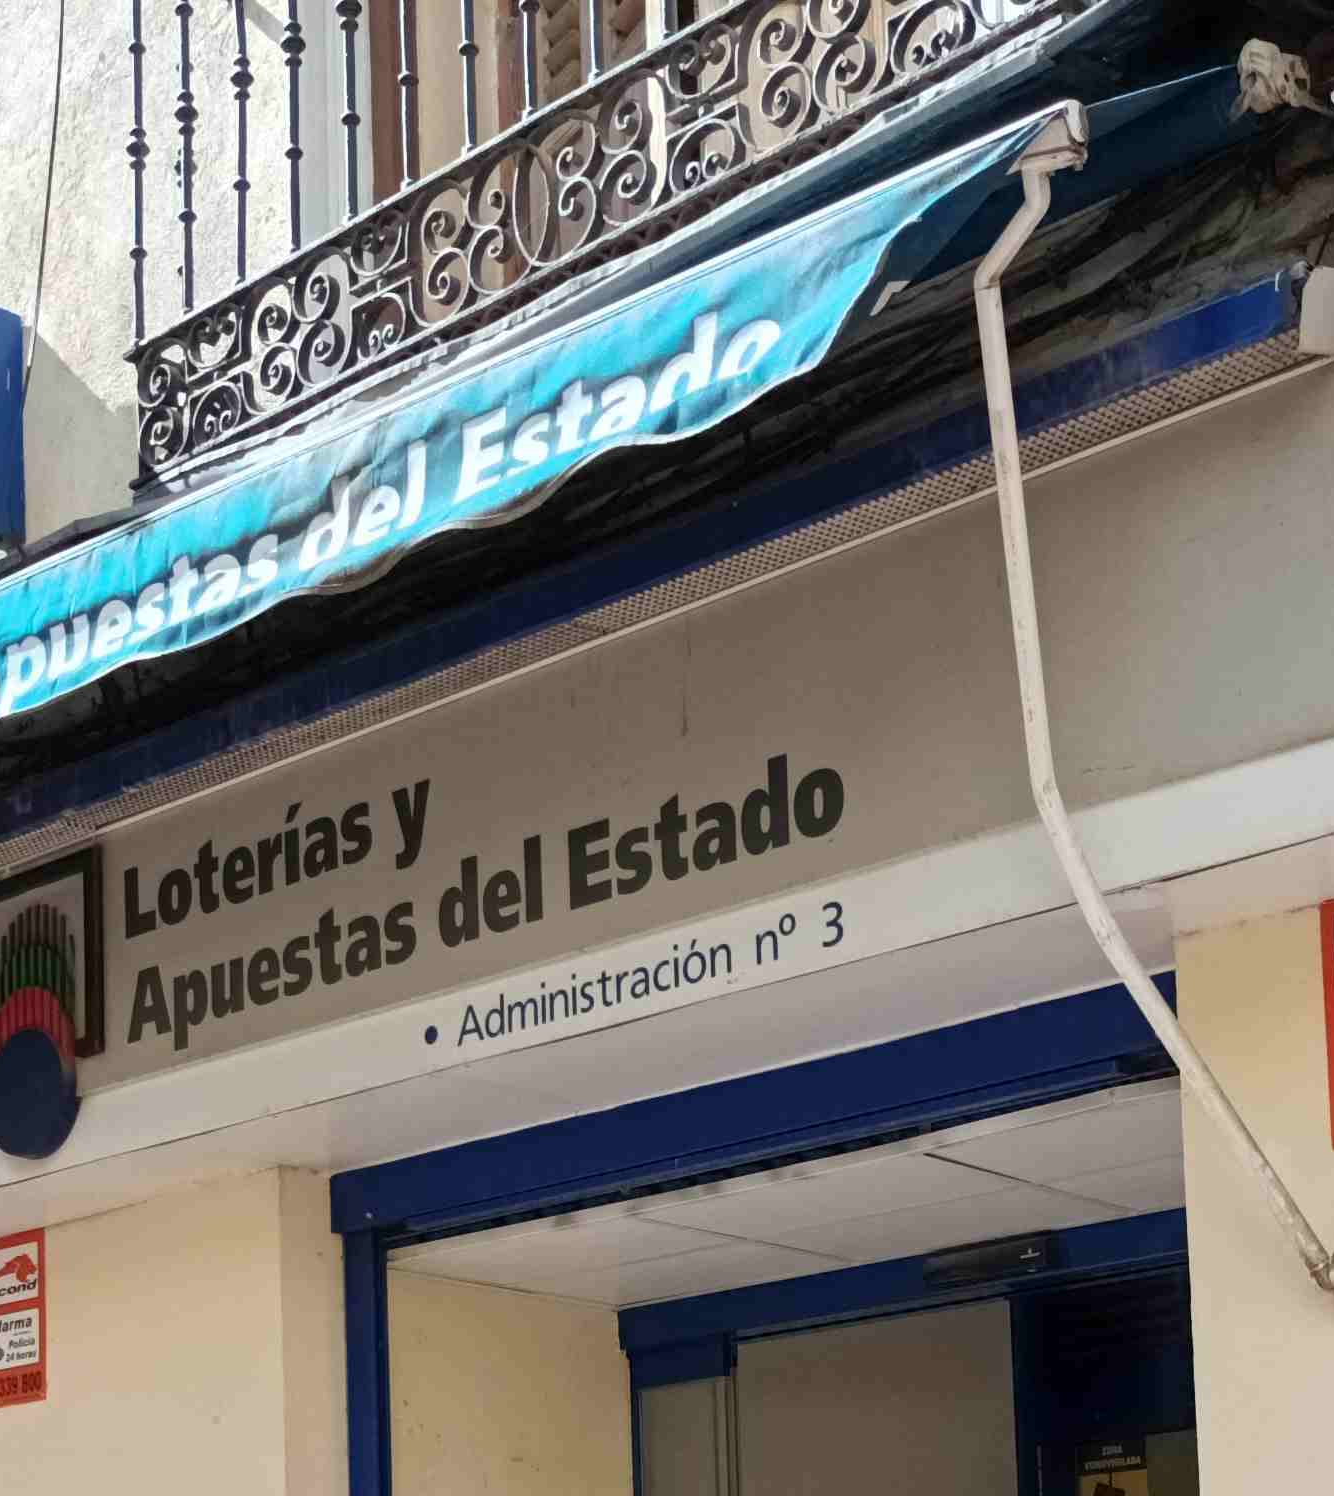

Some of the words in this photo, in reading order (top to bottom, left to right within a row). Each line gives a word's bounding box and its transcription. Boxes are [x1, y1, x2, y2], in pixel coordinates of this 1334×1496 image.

[298, 440, 426, 572] del
[452, 315, 781, 506] Estado
[123, 802, 372, 940] Loterías
[392, 777, 431, 872] y
[127, 893, 417, 1051] Apuestas
[437, 834, 545, 948] del
[568, 752, 845, 912] Estado
[457, 937, 733, 1047] Administración
[755, 911, 797, 968] nº
[821, 900, 845, 948] 3
